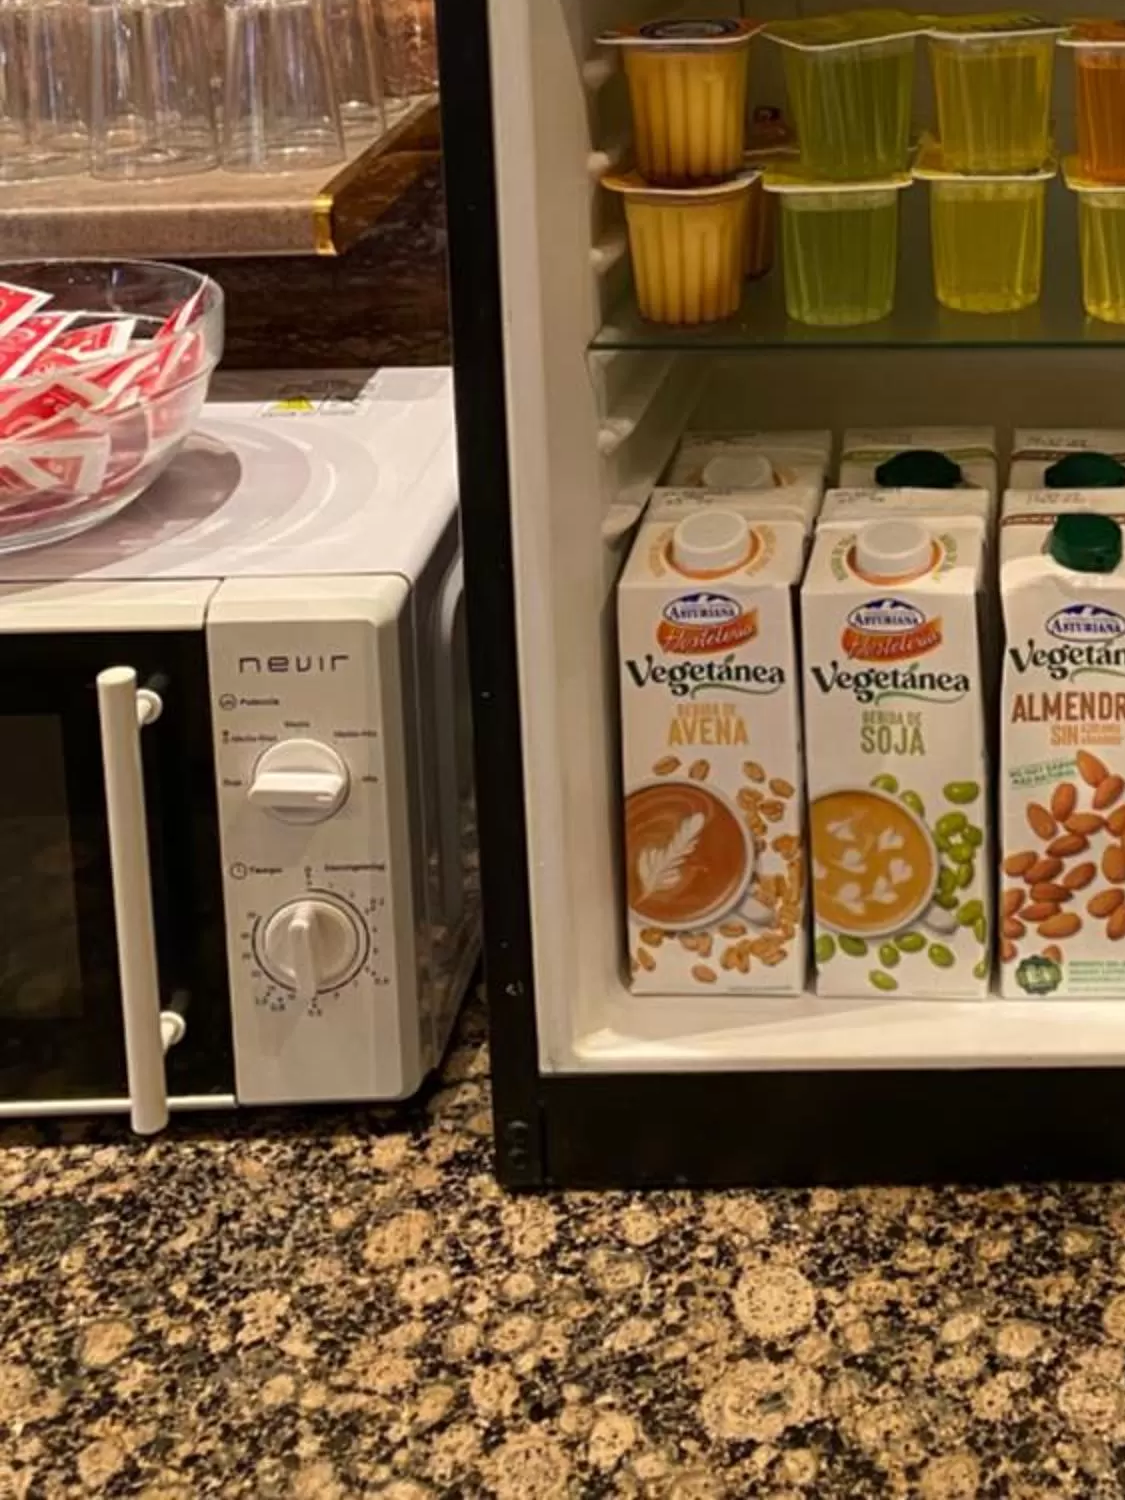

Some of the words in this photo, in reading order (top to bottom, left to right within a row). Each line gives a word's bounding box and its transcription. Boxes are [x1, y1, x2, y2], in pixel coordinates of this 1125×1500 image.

[239, 655, 349, 674] nevir
[625, 653, 786, 697] Vegetánea
[810, 660, 971, 704] Vegetánea
[668, 717, 749, 746] AVENA
[860, 726, 927, 756] SOJA
